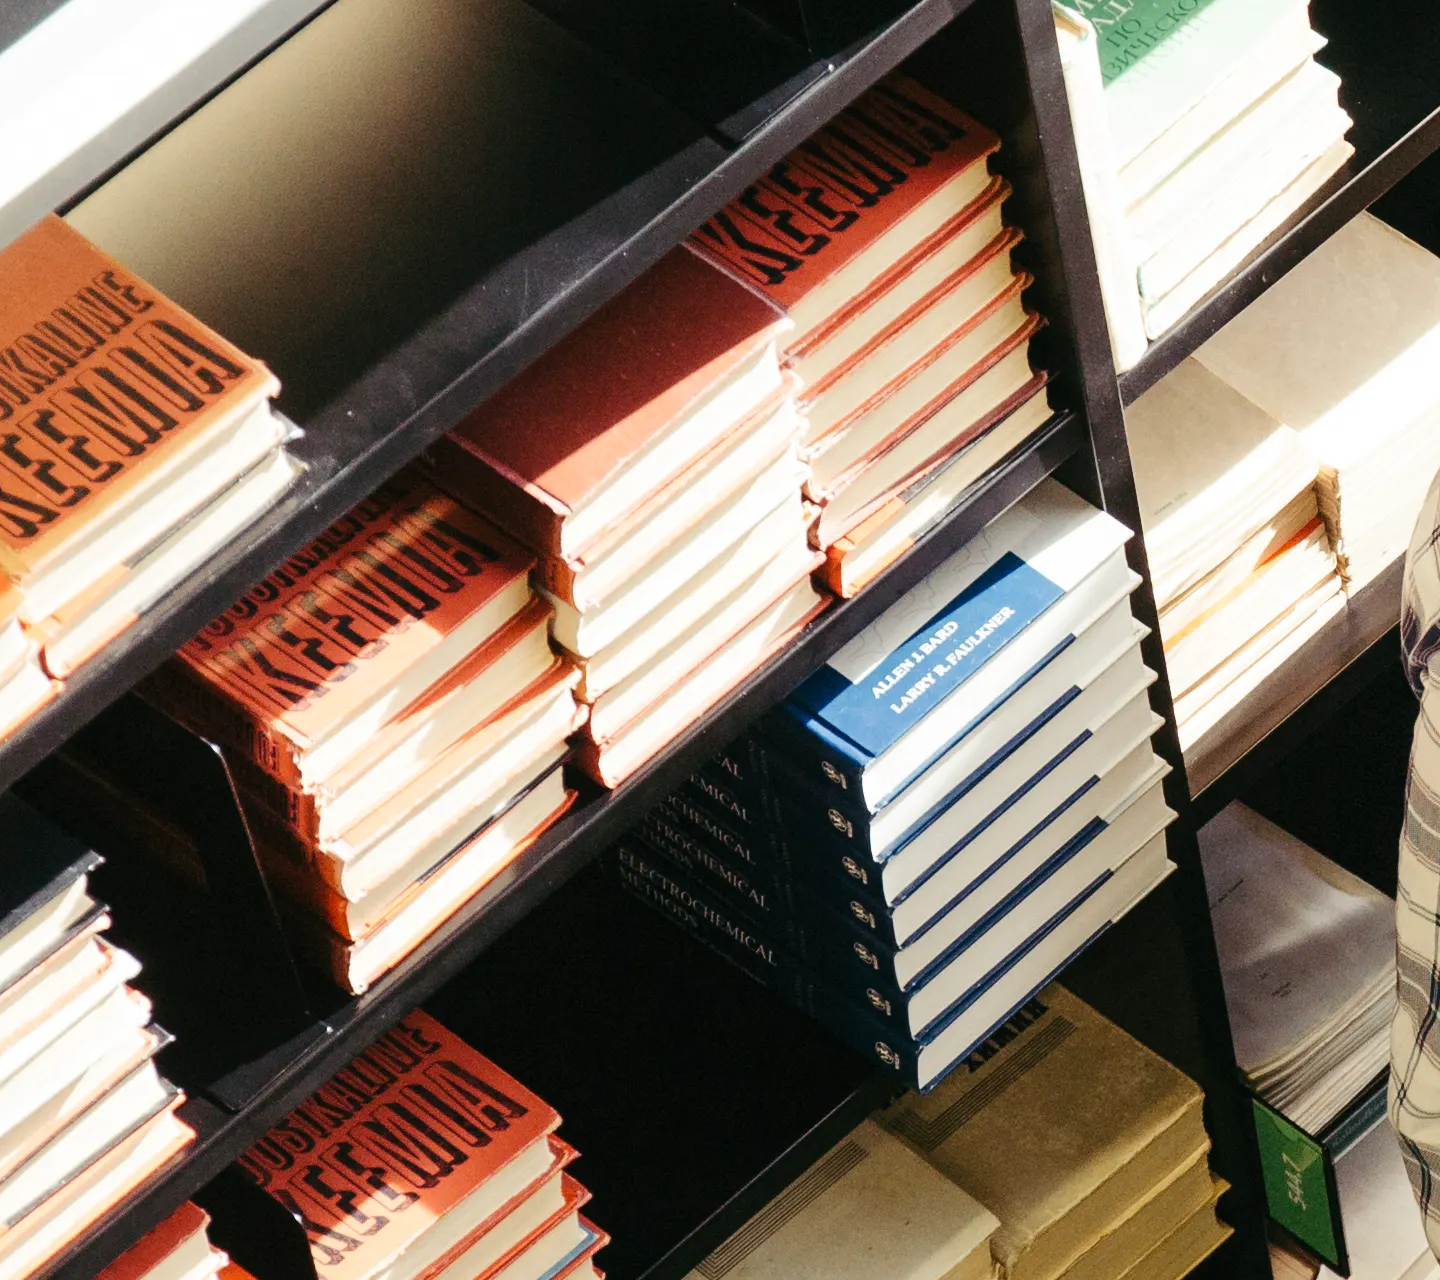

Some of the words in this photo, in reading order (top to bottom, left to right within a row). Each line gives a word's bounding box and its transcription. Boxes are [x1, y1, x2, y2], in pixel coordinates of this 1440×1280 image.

[1106, 18, 1142, 48] ПО
[688, 83, 968, 285] KEEMIA
[211, 518, 500, 712] KEEMIA
[871, 658, 916, 699] ALLEN
[919, 620, 959, 657] BARD
[890, 672, 936, 714] LARRY
[945, 606, 1015, 667] FAULKNER
[618, 847, 778, 967] ELECTROCHEMICAL
